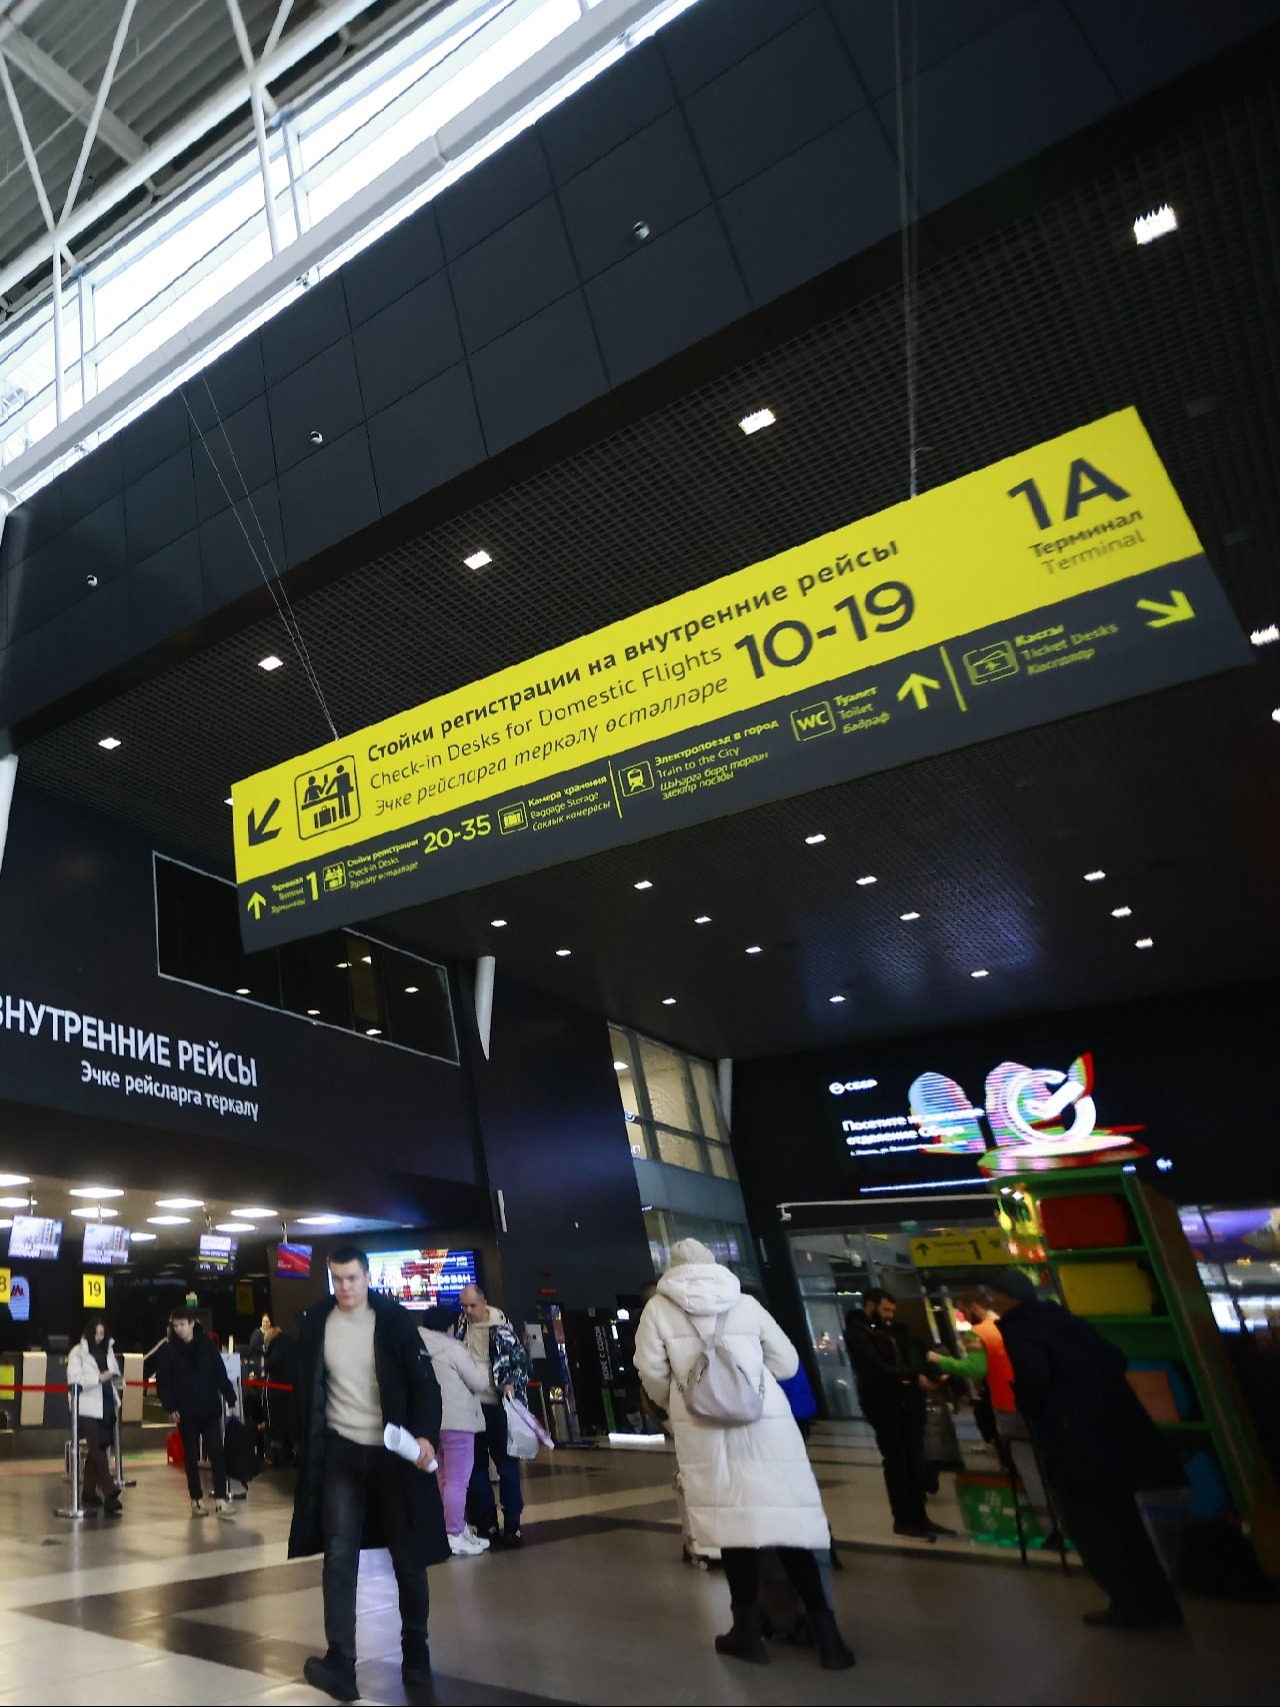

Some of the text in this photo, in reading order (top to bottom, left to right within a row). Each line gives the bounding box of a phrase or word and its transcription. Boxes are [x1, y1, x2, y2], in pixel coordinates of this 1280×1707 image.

[1029, 510, 1143, 557] Терминал
[1041, 530, 1146, 575] Terminal
[734, 580, 916, 680] 10-19
[1014, 624, 1065, 647] Кассы
[1020, 623, 1119, 660] Ticket Desks
[368, 541, 899, 762] Стойки регистрации на внутренние рейсы
[833, 687, 878, 707] Туалет
[837, 703, 874, 719] Toilet
[370, 645, 723, 789] Check-in Desks for Domestic Flights
[796, 710, 829, 731] WC
[375, 676, 729, 817] Эчке рейсларга теркәлү өстәлләре
[654, 720, 779, 767] Электропоезд в город
[657, 746, 740, 779] Train to the City
[527, 775, 608, 807] Камера хранения
[530, 791, 599, 819] Baggage Storage
[566, 800, 611, 821] камерасы
[423, 814, 491, 855] 20-35
[346, 838, 419, 868] Стойки регистрации
[348, 857, 400, 879] Check-in Desks
[271, 877, 304, 892] Терминал
[306, 871, 319, 901] 1
[177, 1040, 258, 1088] РЕЙСЫ
[80, 1060, 259, 1122] Эчке рейсларга теркәлү
[841, 1116, 907, 1132] Посетите
[846, 1130, 918, 1145] отделение
[88, 1280, 101, 1297] 19
